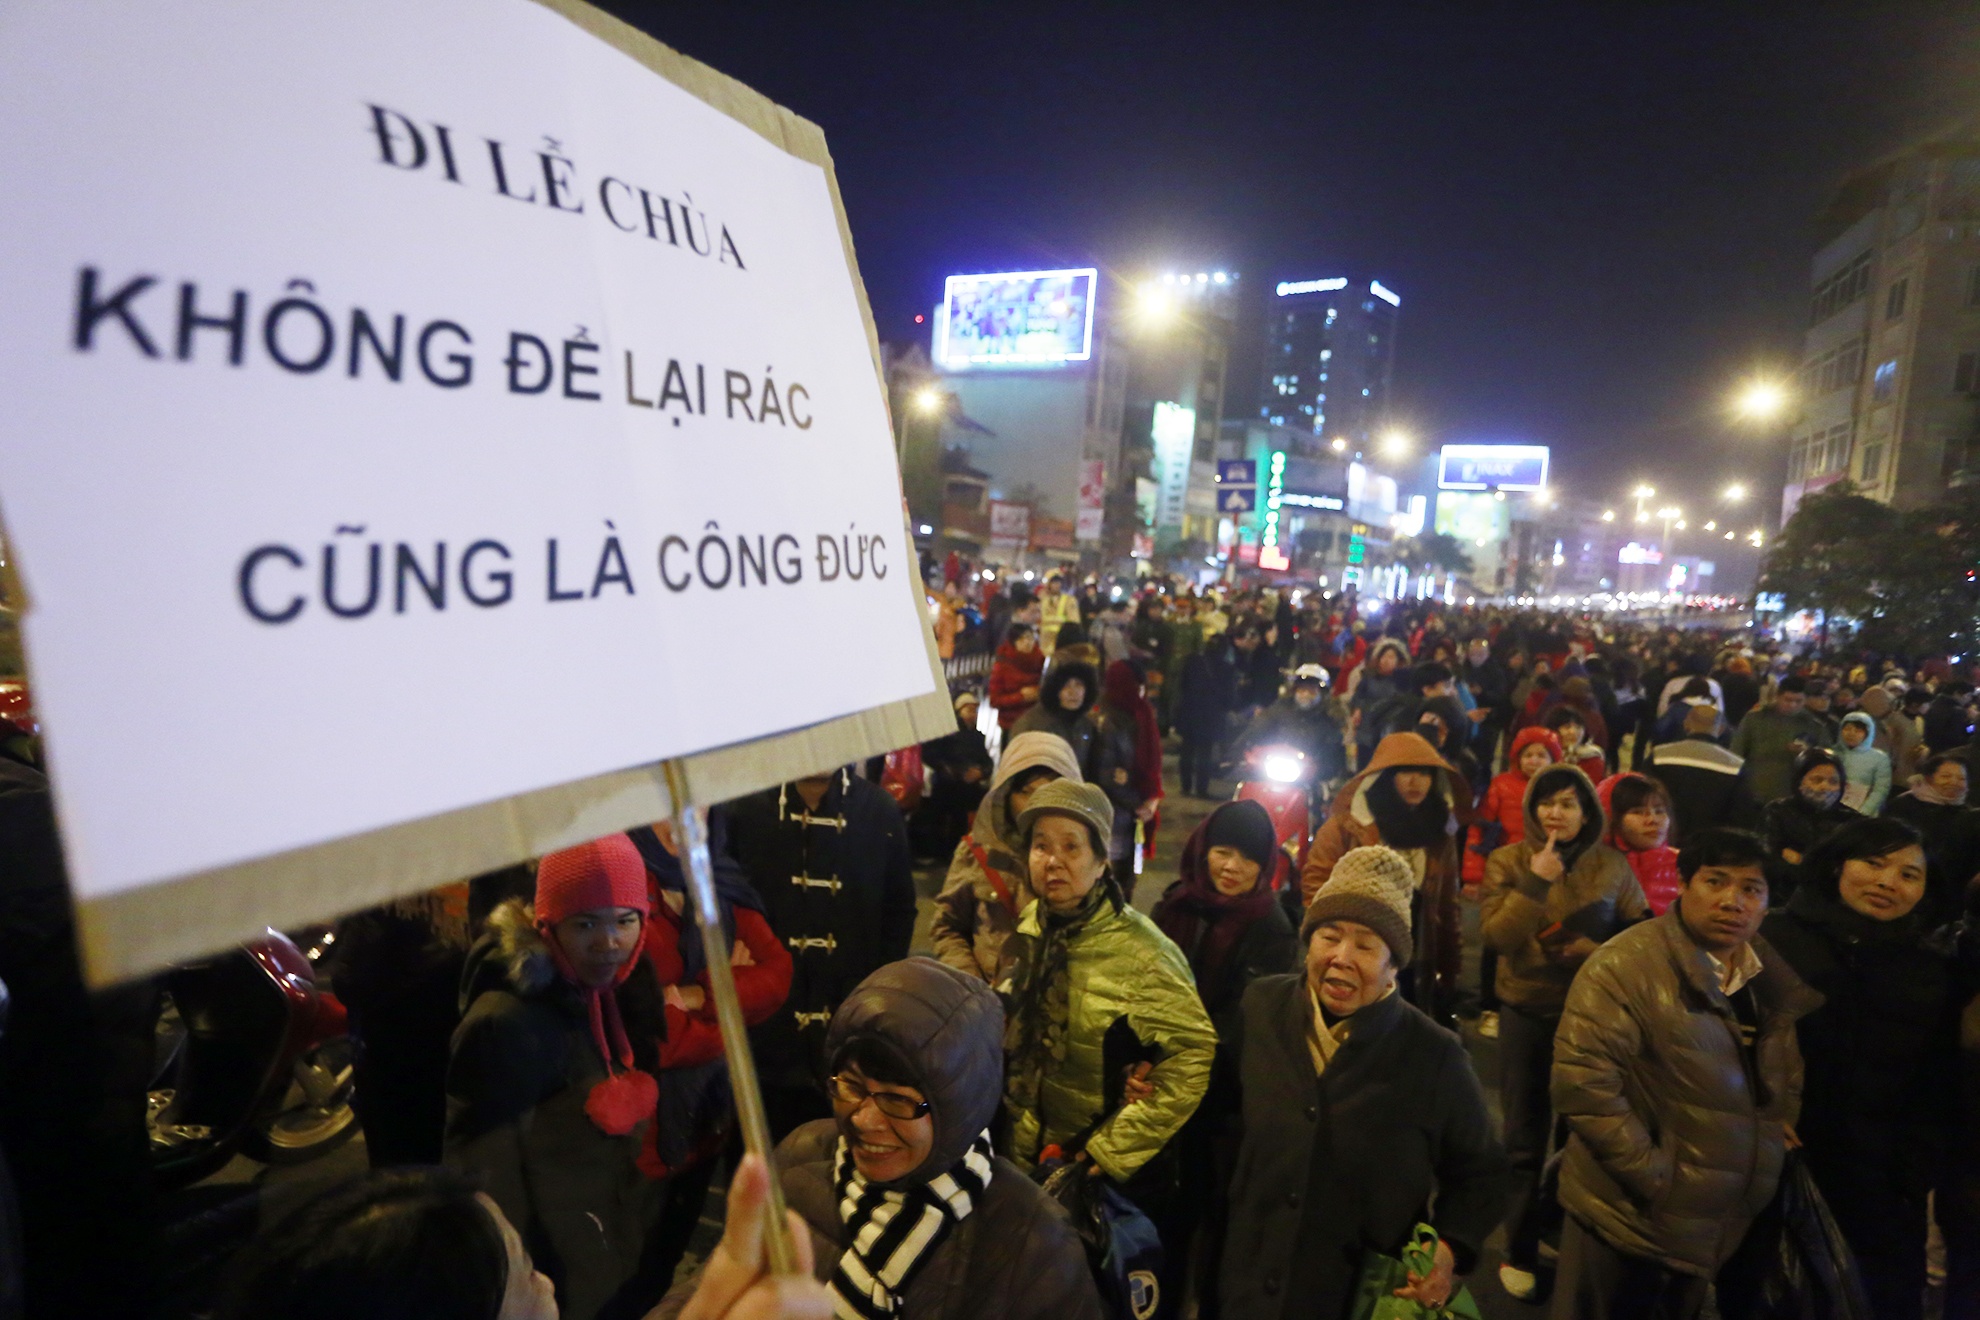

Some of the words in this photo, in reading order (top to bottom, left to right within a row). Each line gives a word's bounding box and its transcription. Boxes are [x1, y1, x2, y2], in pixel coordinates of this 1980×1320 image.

[366, 102, 464, 185] ĐI
[484, 135, 584, 215] LỄ
[597, 174, 747, 270] CHÙA
[69, 264, 475, 391] KHÔNG
[502, 325, 602, 402] ĐỂ
[624, 349, 706, 428] LẠI
[724, 365, 814, 431] RÁC
[235, 524, 515, 627] CŨNG
[545, 519, 637, 605] LÀ
[657, 519, 804, 594] CÔNG
[815, 520, 889, 583] ĐỨC
